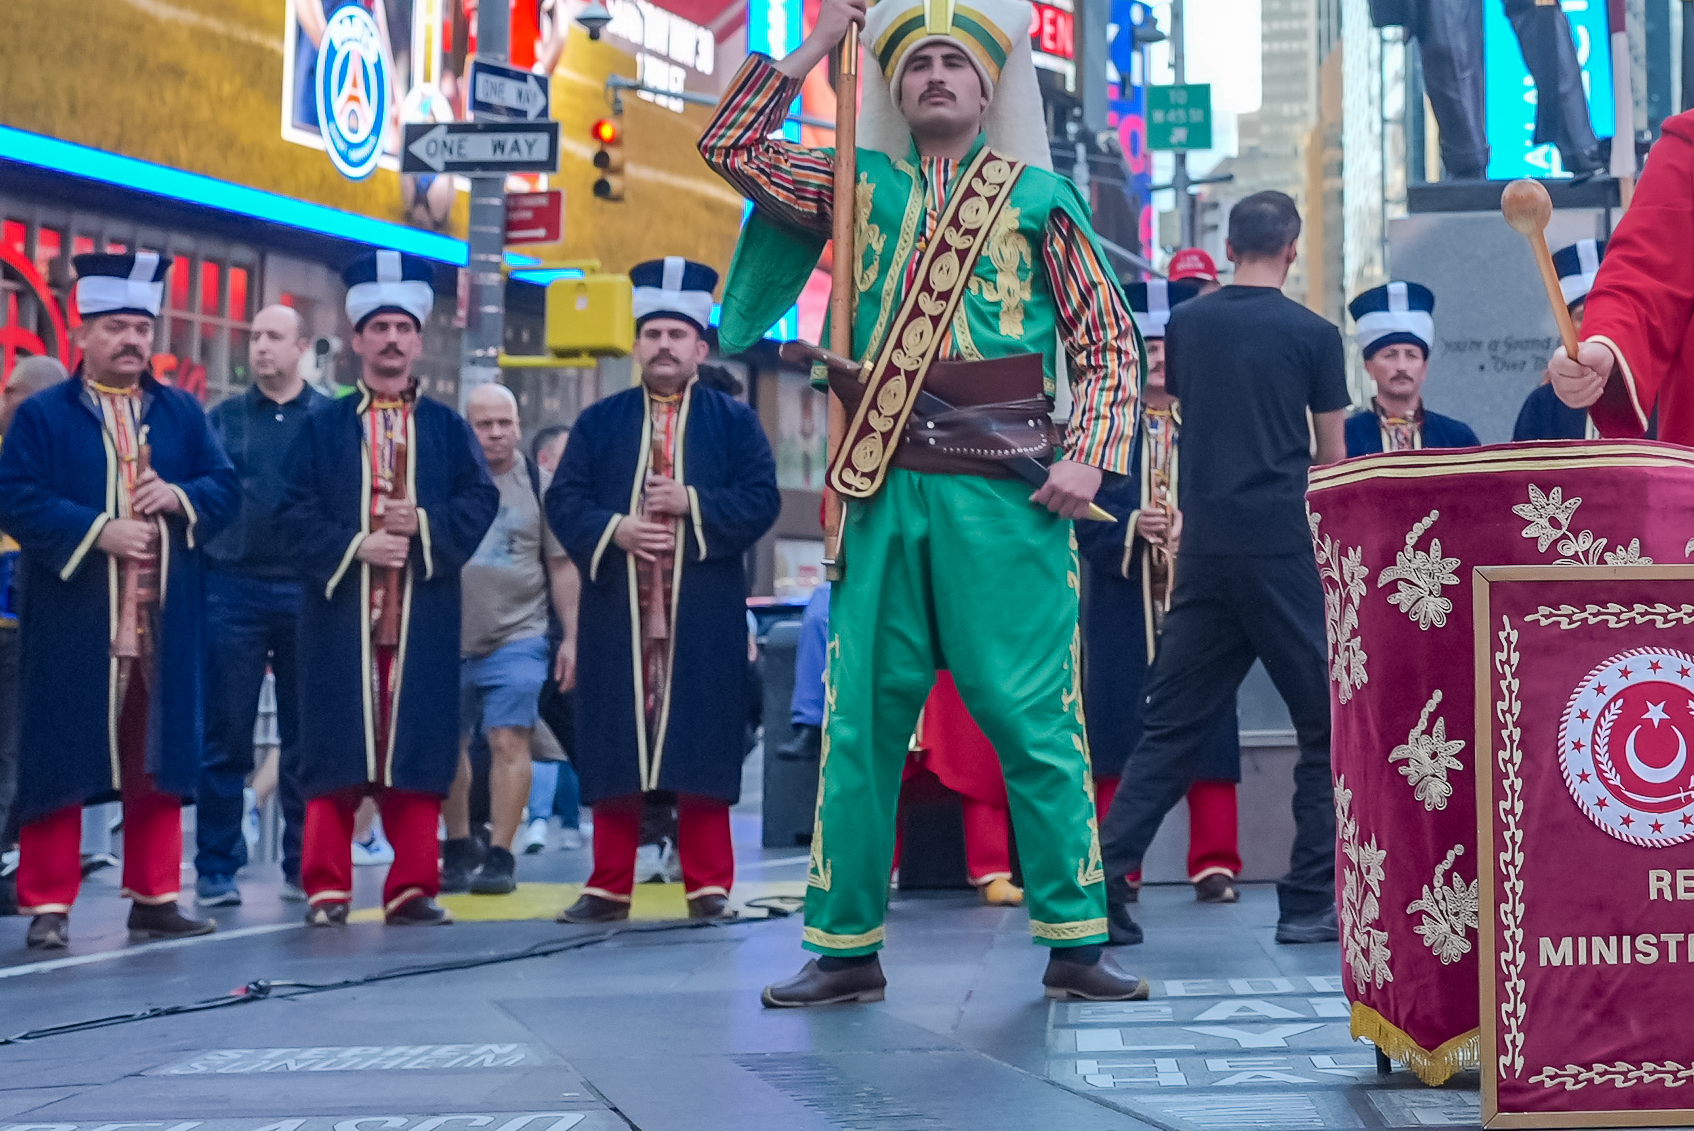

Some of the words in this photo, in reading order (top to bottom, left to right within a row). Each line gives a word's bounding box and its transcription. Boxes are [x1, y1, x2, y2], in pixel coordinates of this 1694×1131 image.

[481, 73, 506, 101] ONE
[515, 82, 540, 104] WAY
[425, 138, 468, 159] ONE
[491, 134, 539, 157] WAY
